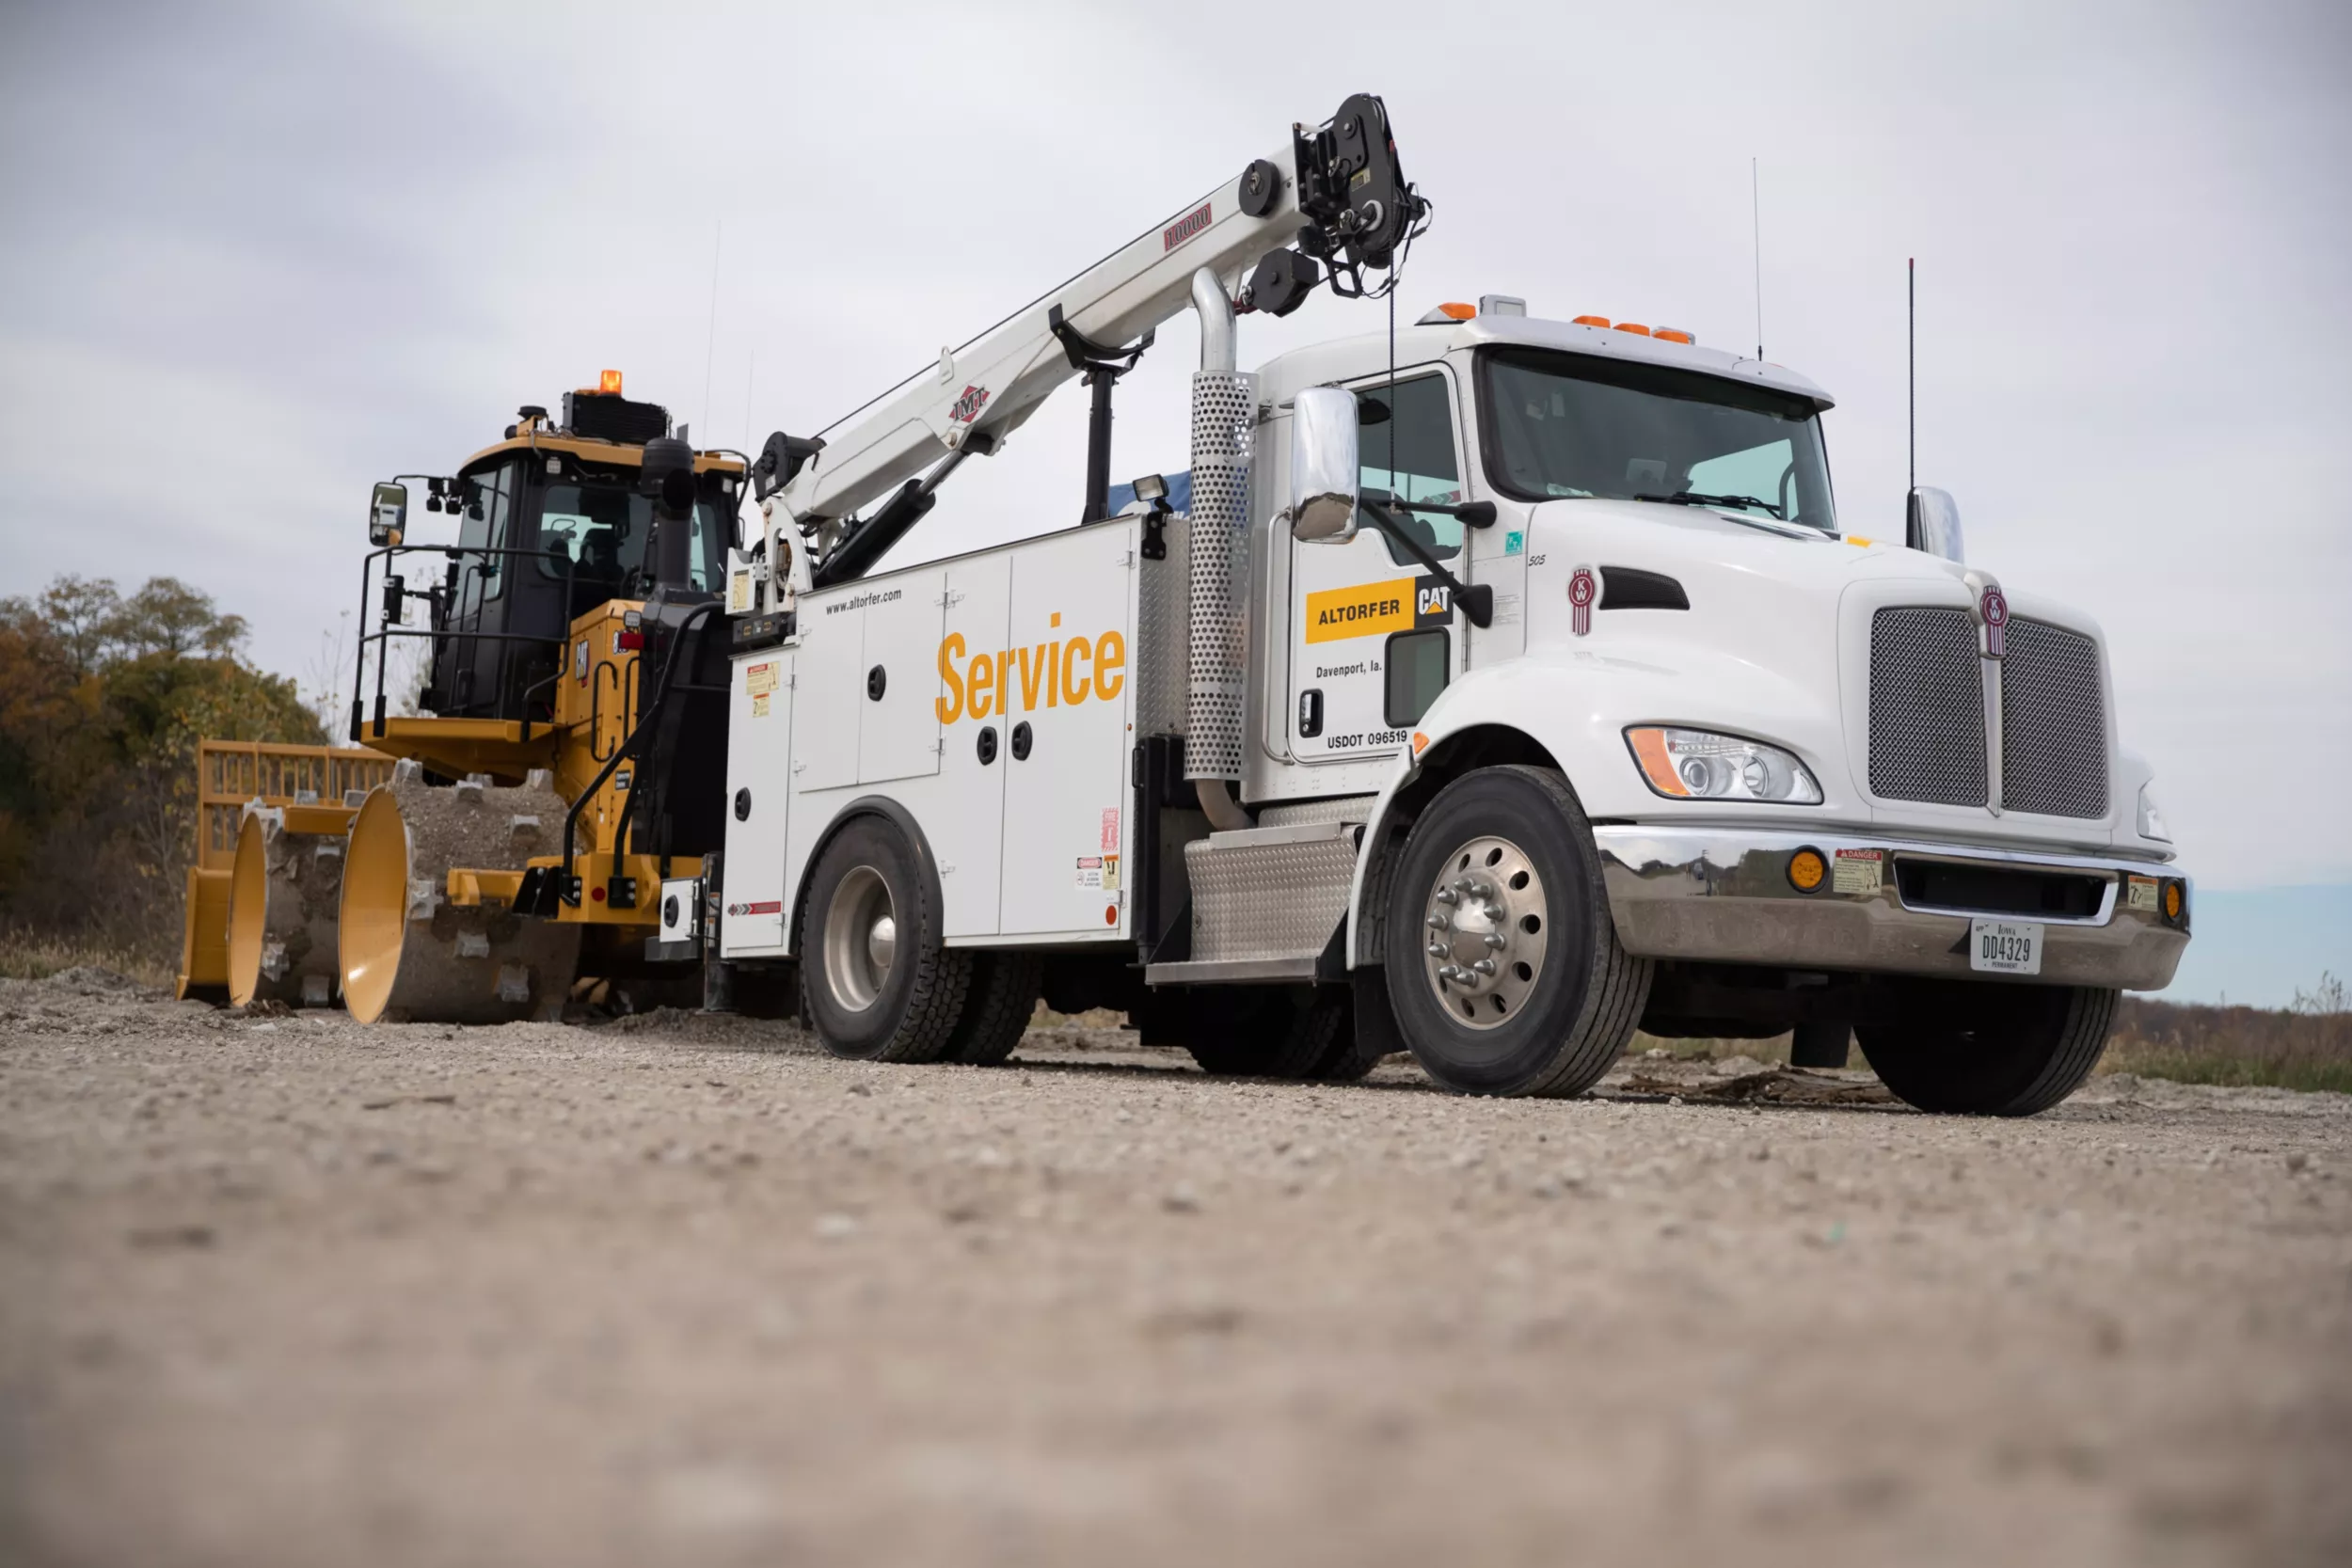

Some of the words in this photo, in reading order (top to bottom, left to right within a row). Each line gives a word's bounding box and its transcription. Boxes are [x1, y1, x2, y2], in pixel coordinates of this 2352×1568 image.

[1168, 207, 1209, 248] 10000
[953, 387, 985, 421] IMT
[1528, 554, 1546, 567] 505
[826, 589, 902, 616] www.altorfer.com
[1318, 599, 1401, 626] ALTORFER
[1419, 586, 1451, 615] CAT
[935, 611, 1125, 725] Service
[1316, 661, 1367, 678] Davenport,
[1327, 735, 1364, 749] USDOT
[1367, 730, 1407, 745] 096519
[1848, 850, 1879, 860] DANGER
[1982, 935, 2030, 962] DD4329
